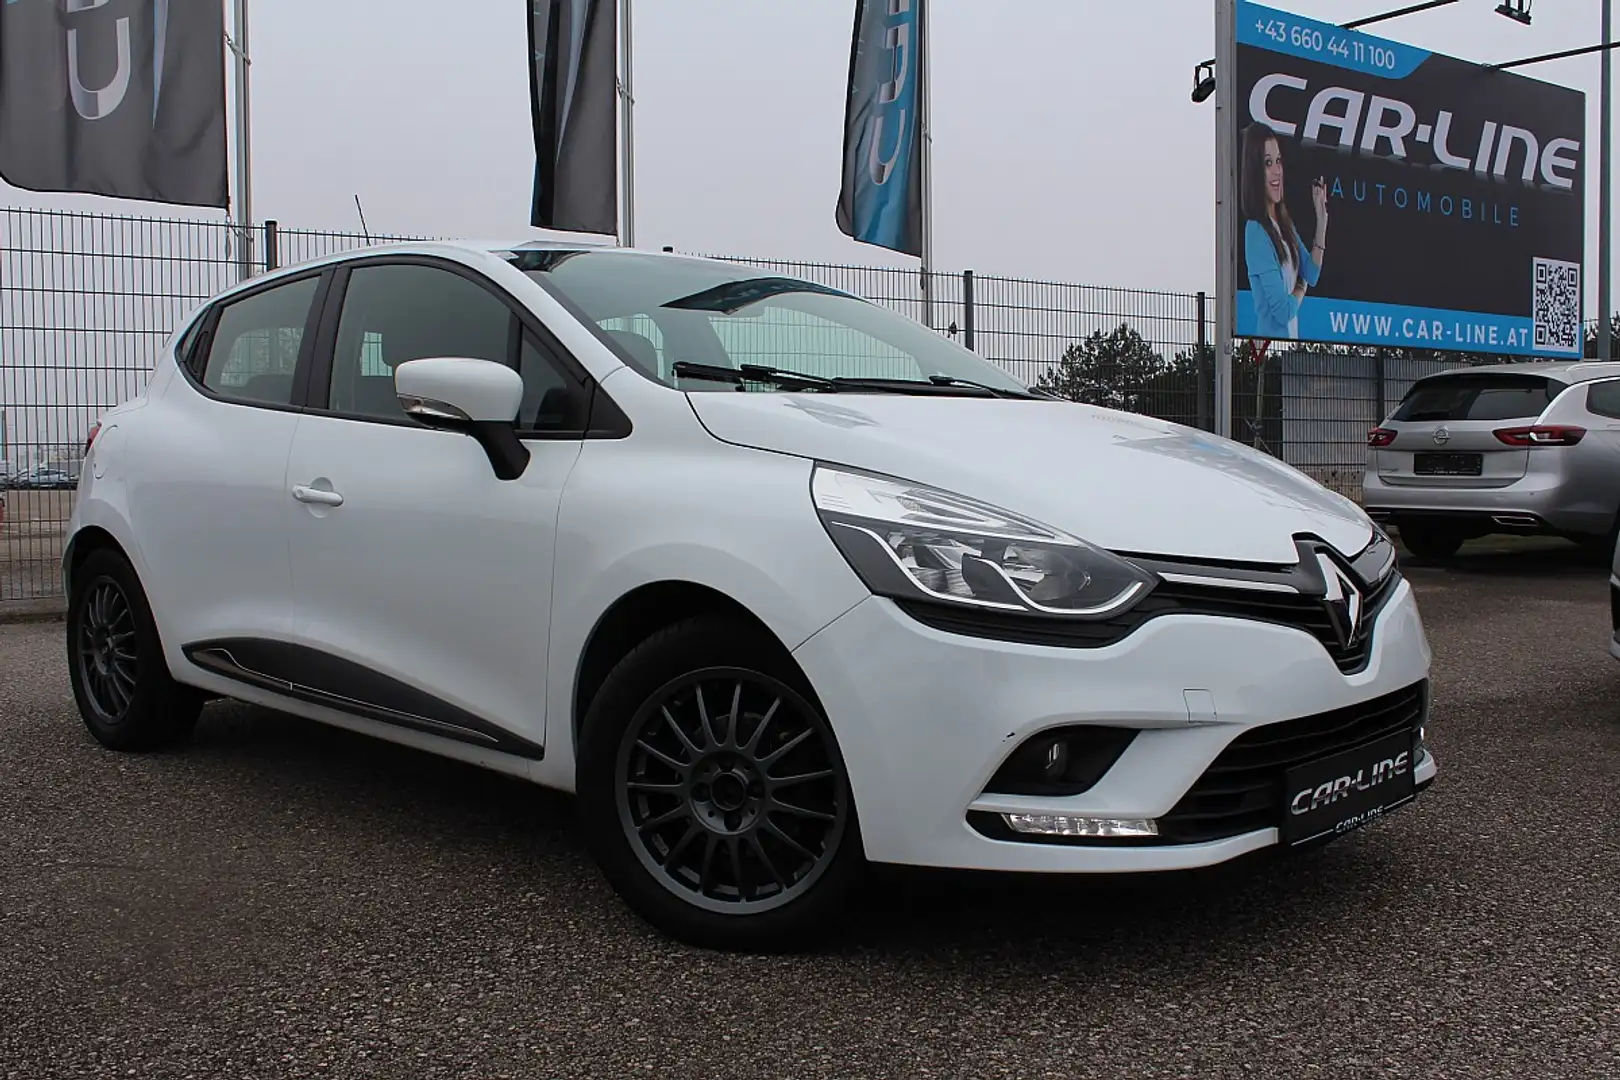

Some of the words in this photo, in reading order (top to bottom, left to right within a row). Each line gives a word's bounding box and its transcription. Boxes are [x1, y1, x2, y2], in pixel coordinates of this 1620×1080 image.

[1255, 19, 1287, 43] +43
[1291, 26, 1323, 52] 660
[1327, 36, 1350, 59] 44
[1352, 41, 1365, 64] 11
[1368, 45, 1396, 70] 100
[1331, 176, 1520, 227] AUTOMOBILE
[1329, 311, 1529, 347] WWW.CAR-LINE.AT
